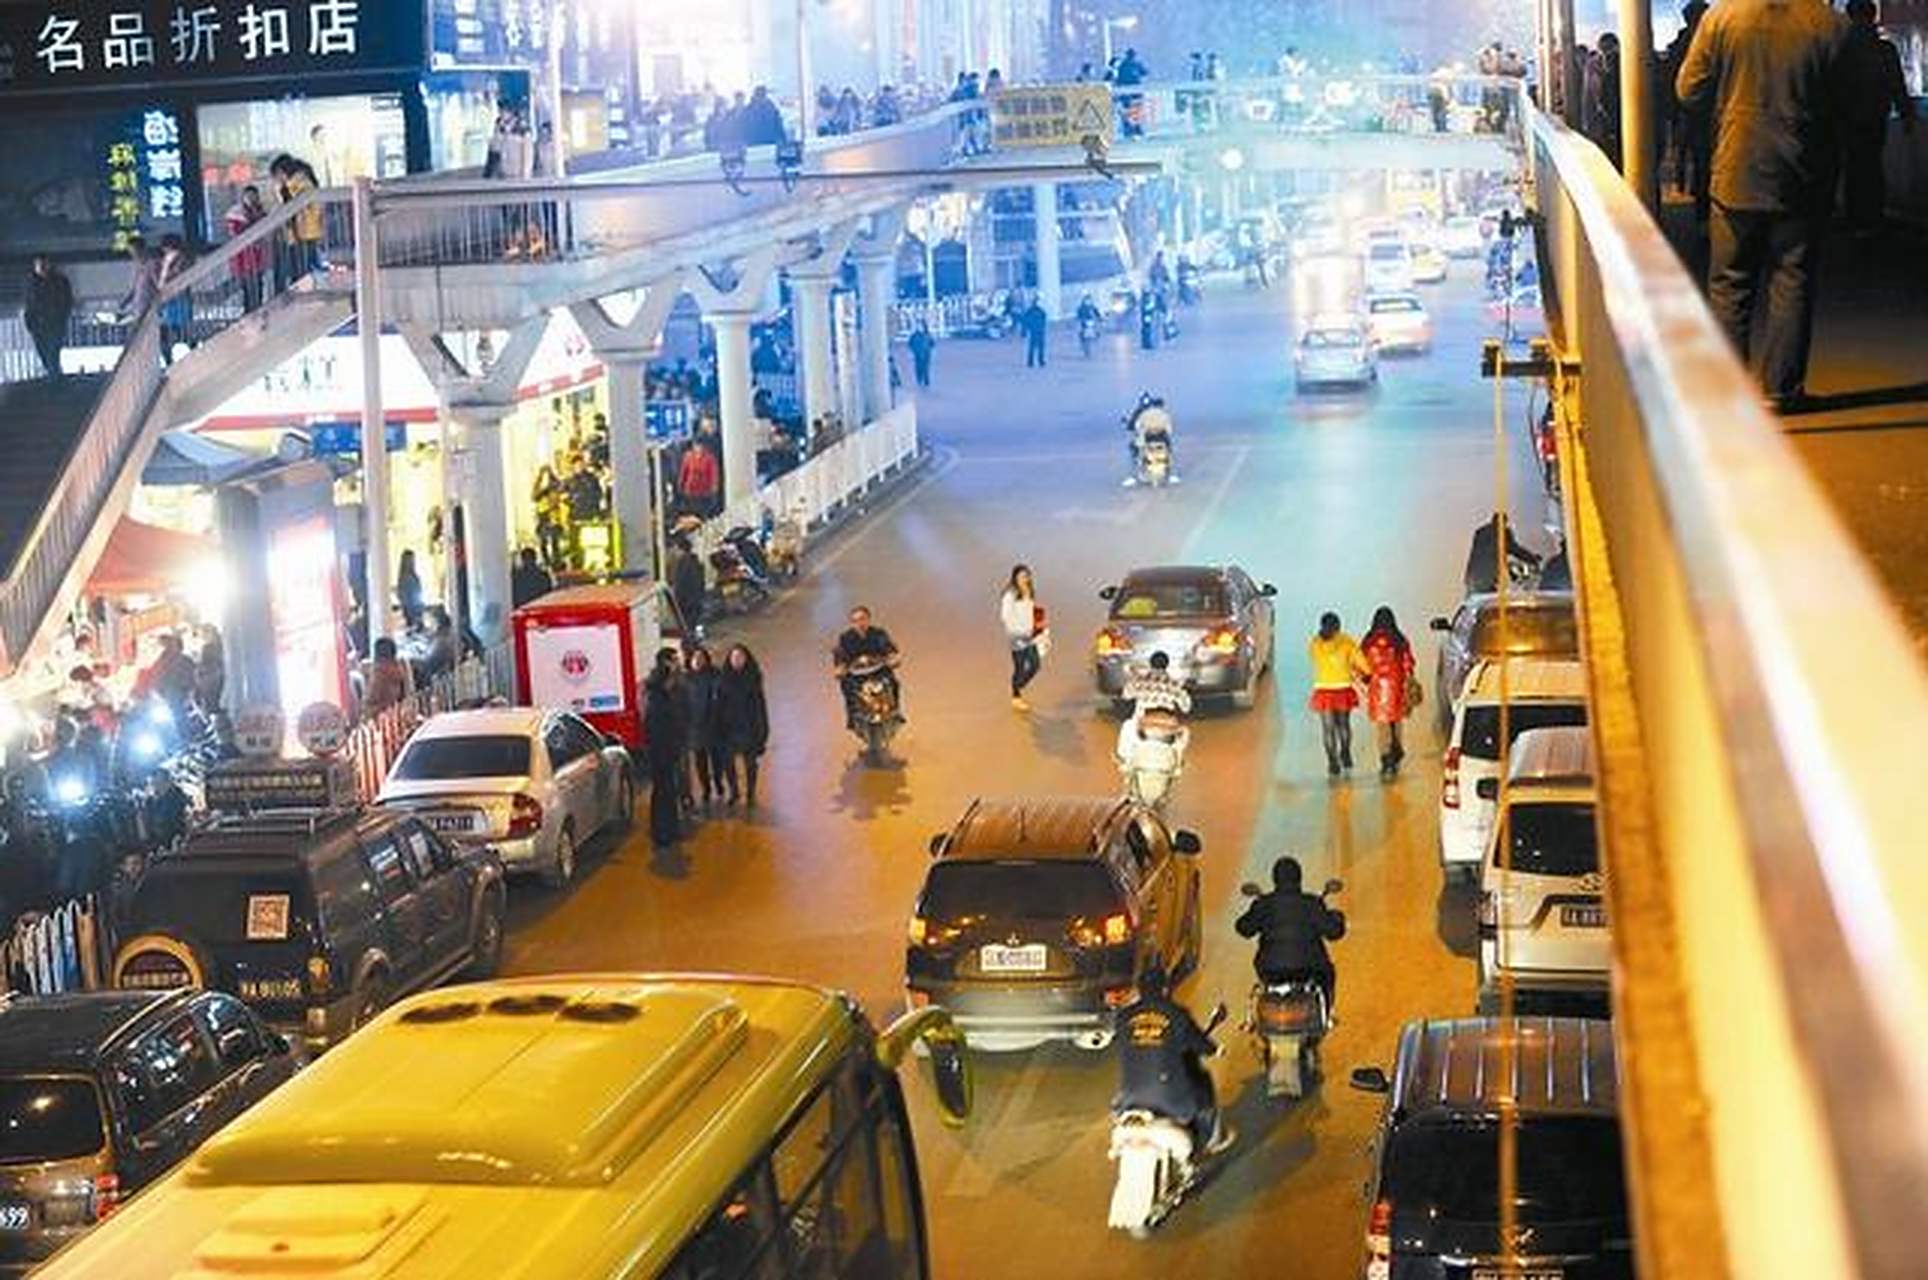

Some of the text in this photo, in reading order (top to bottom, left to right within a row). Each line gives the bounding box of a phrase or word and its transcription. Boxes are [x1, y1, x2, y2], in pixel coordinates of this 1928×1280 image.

[37, 1, 358, 72] 名品折扣店
